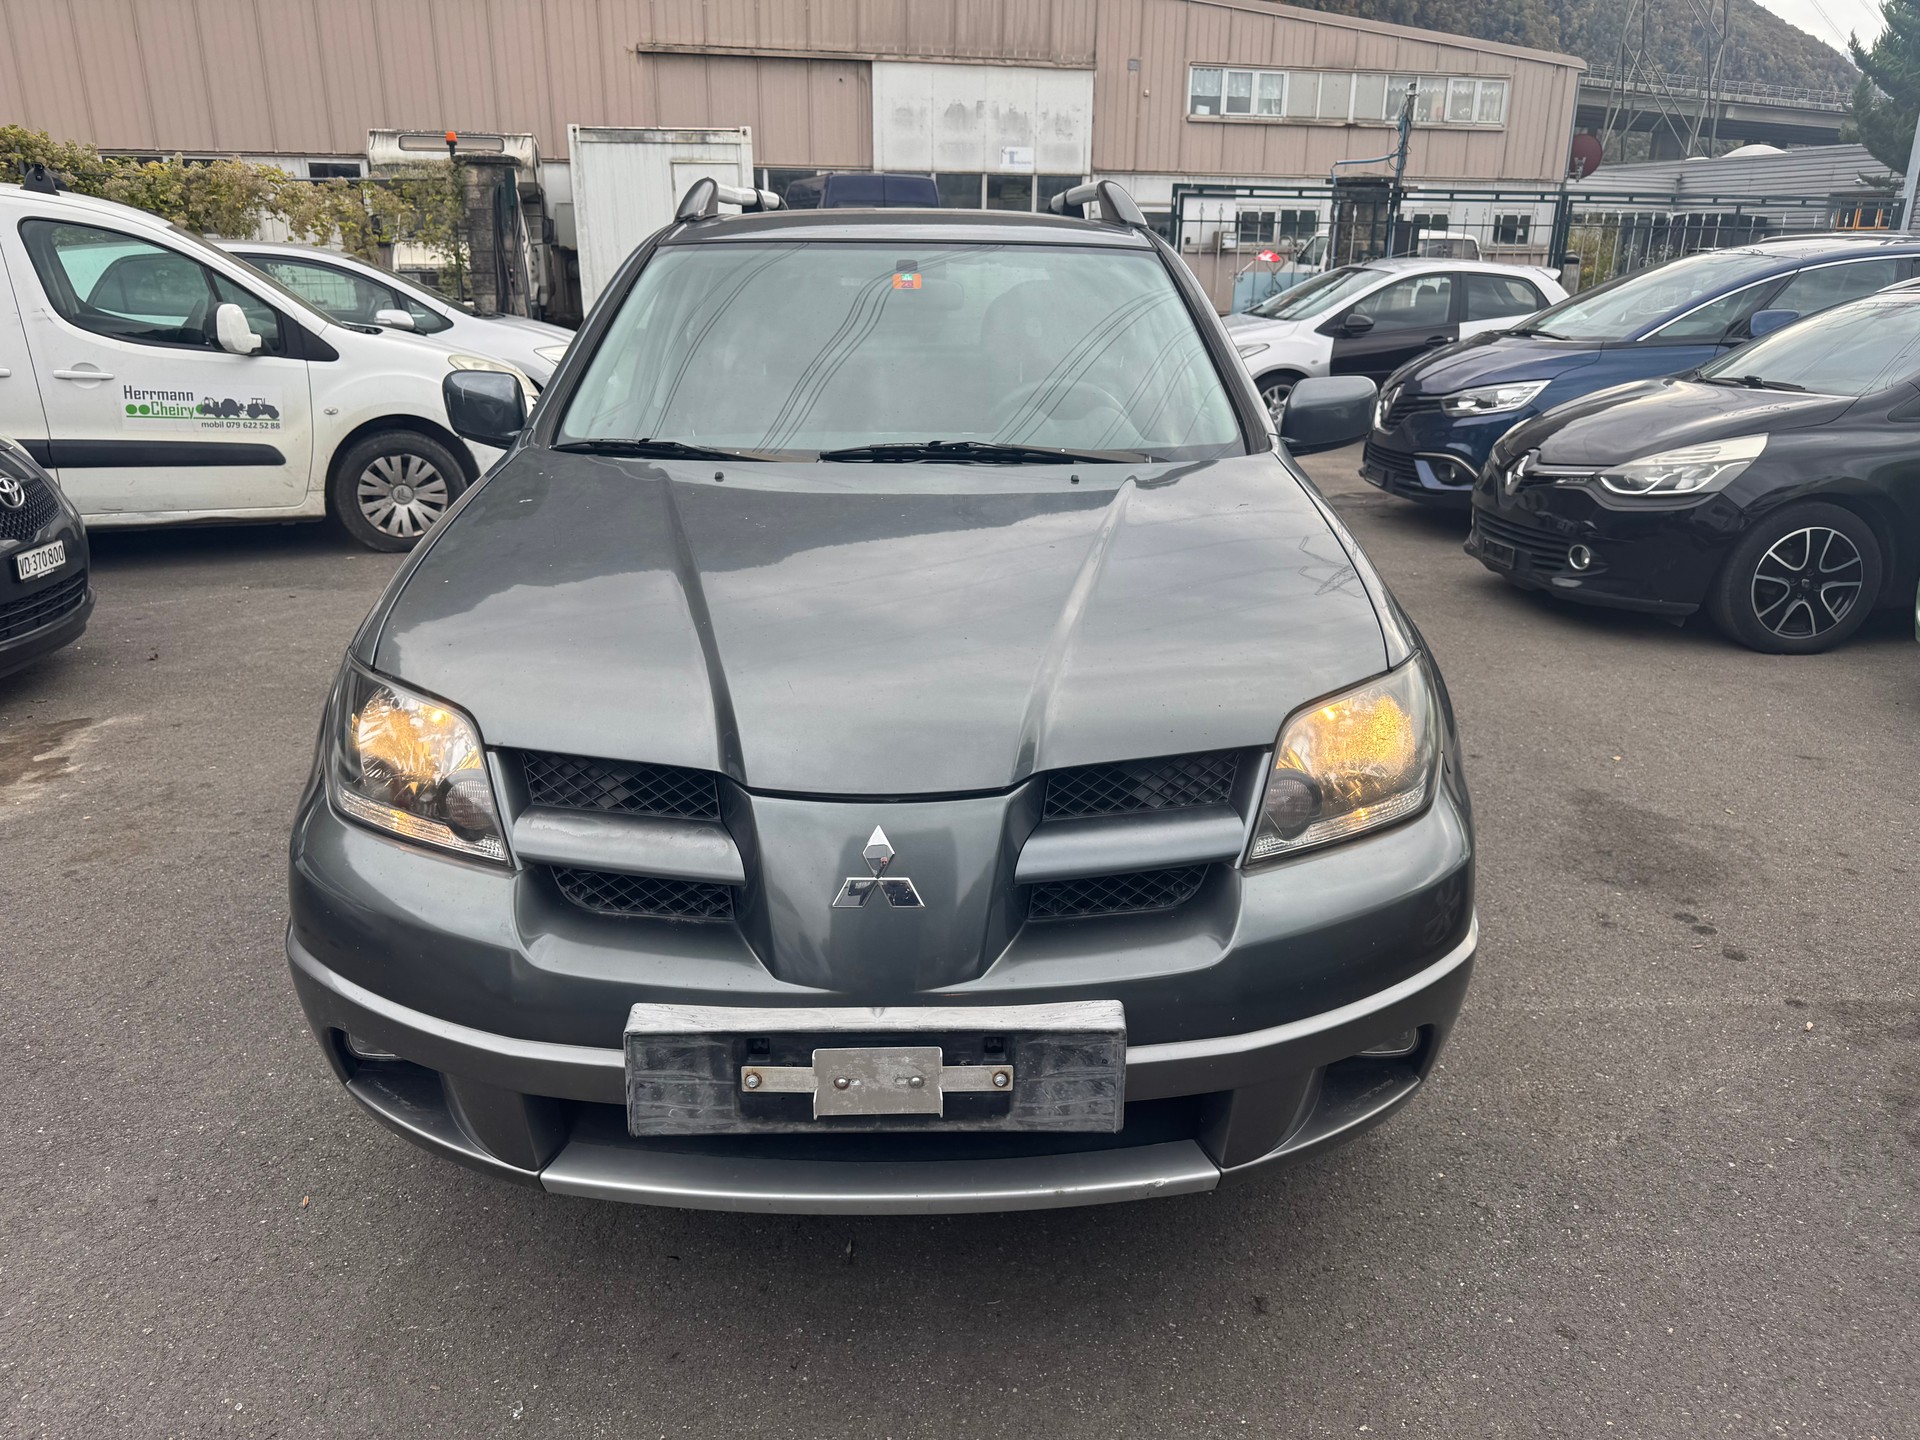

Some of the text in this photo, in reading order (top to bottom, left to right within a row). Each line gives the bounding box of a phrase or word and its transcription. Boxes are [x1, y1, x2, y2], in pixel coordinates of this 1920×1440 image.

[123, 385, 194, 402] Herrmann
[151, 401, 195, 419] Cheiry
[201, 421, 225, 429] mobil
[226, 421, 241, 429] 079
